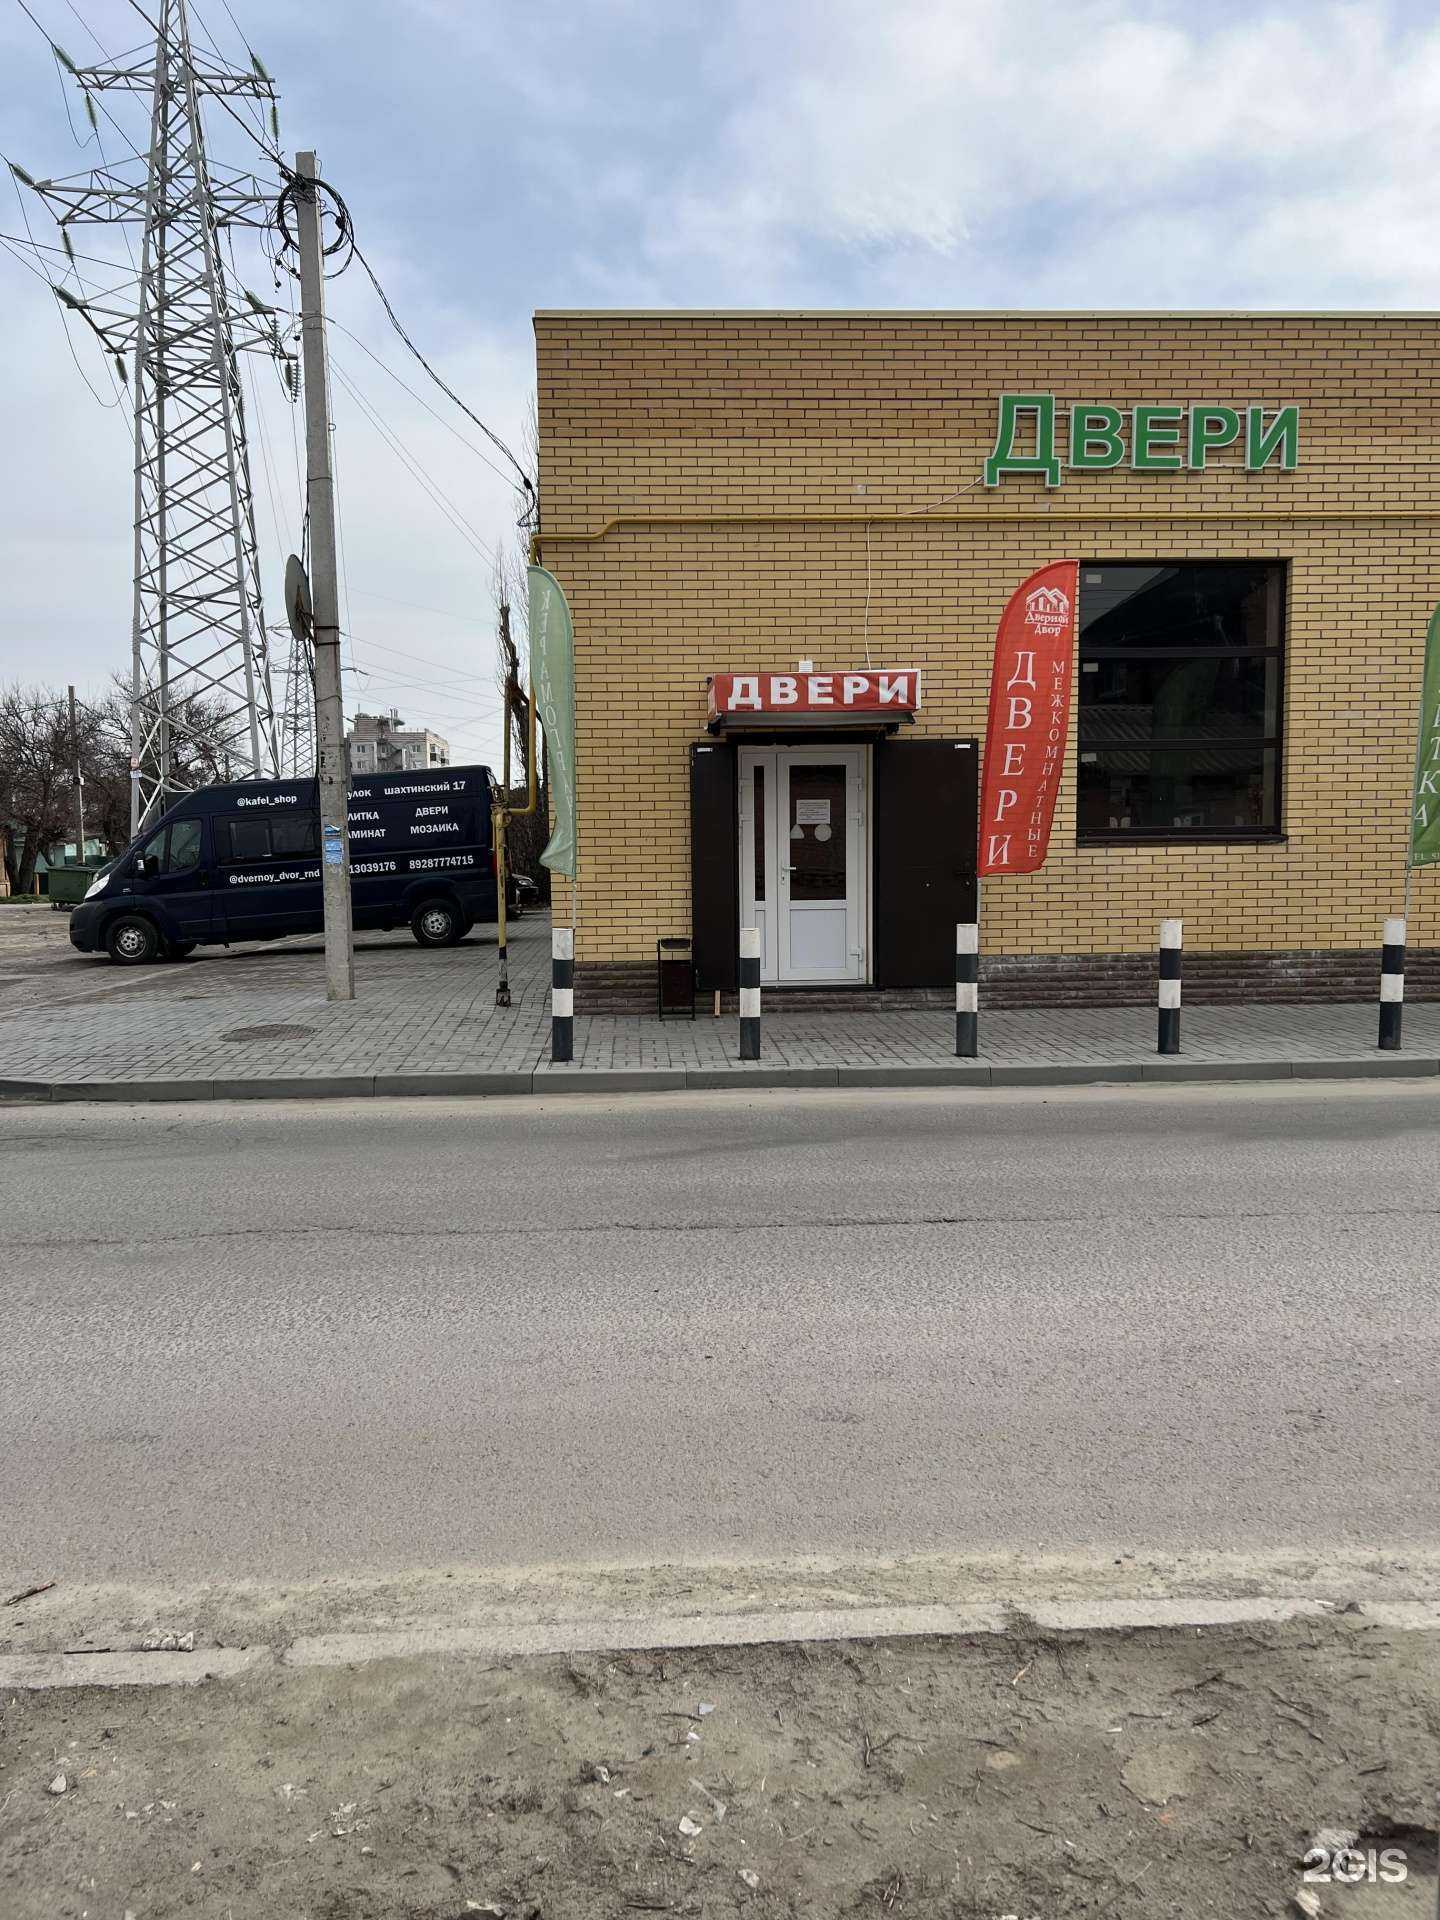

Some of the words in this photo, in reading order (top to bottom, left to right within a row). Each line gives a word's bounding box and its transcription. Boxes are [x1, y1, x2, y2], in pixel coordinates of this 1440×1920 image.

[984, 394, 1300, 487] ДВЕРИ
[1024, 611, 1069, 625] Дверной
[1035, 624, 1061, 637] Двор
[727, 676, 908, 710] ДВЕРИ
[985, 651, 1037, 867] ДВЕРИ
[1027, 661, 1065, 857] МЕЖКОМНАТНЫЕ
[346, 789, 372, 800] улок
[384, 781, 450, 796] шахтинский
[452, 780, 467, 791] 17
[237, 795, 298, 807] @kafel_shop
[347, 811, 380, 822] ЛИТКА
[415, 805, 449, 818] ДВЕРИ
[347, 828, 387, 840] МИНАТ
[410, 822, 460, 835] МОЗАИКА
[349, 861, 397, 875] 13039176
[409, 855, 475, 870] 89287774715
[229, 868, 321, 885] @dvernoy_dvor_rnd
